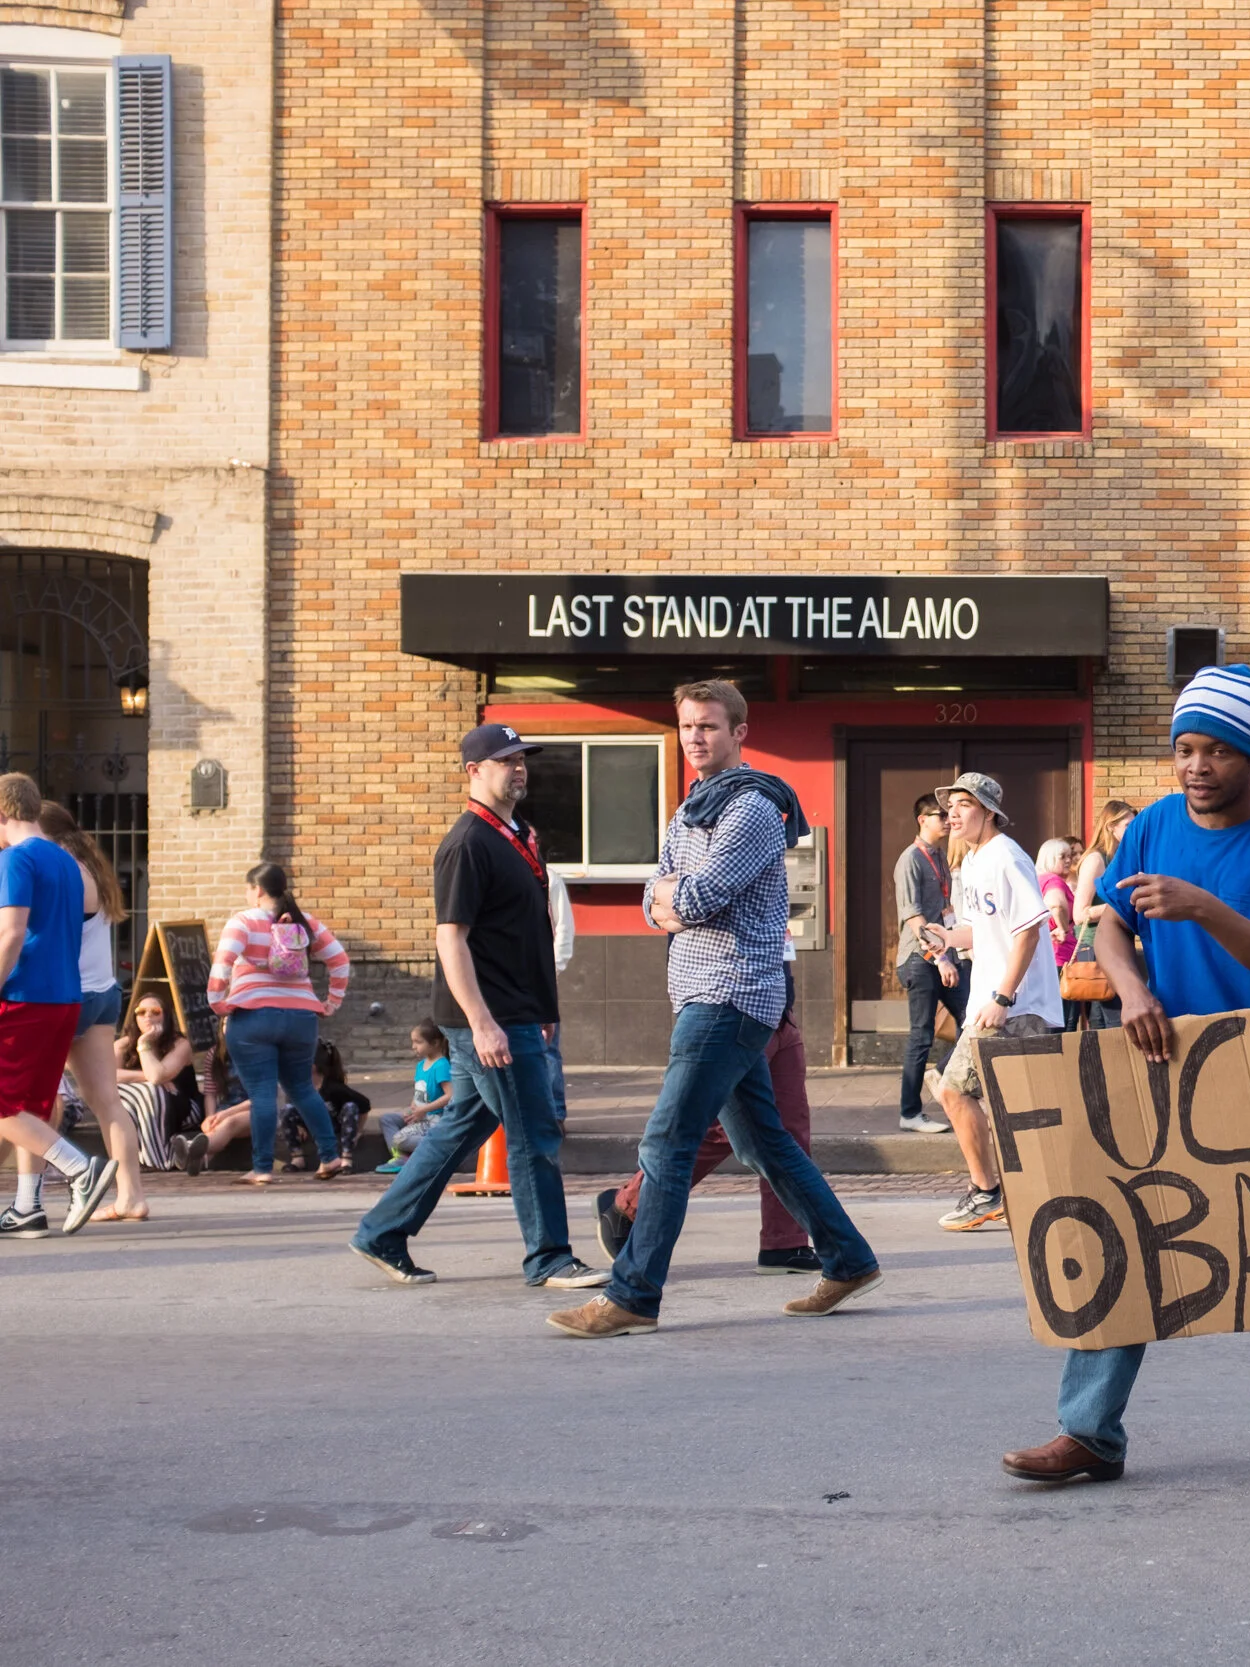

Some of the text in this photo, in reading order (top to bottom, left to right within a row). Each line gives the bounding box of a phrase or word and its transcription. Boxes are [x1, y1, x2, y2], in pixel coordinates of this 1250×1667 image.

[528, 594, 979, 640] LAST STAND AT THE ALAMO
[935, 703, 977, 723] 320
